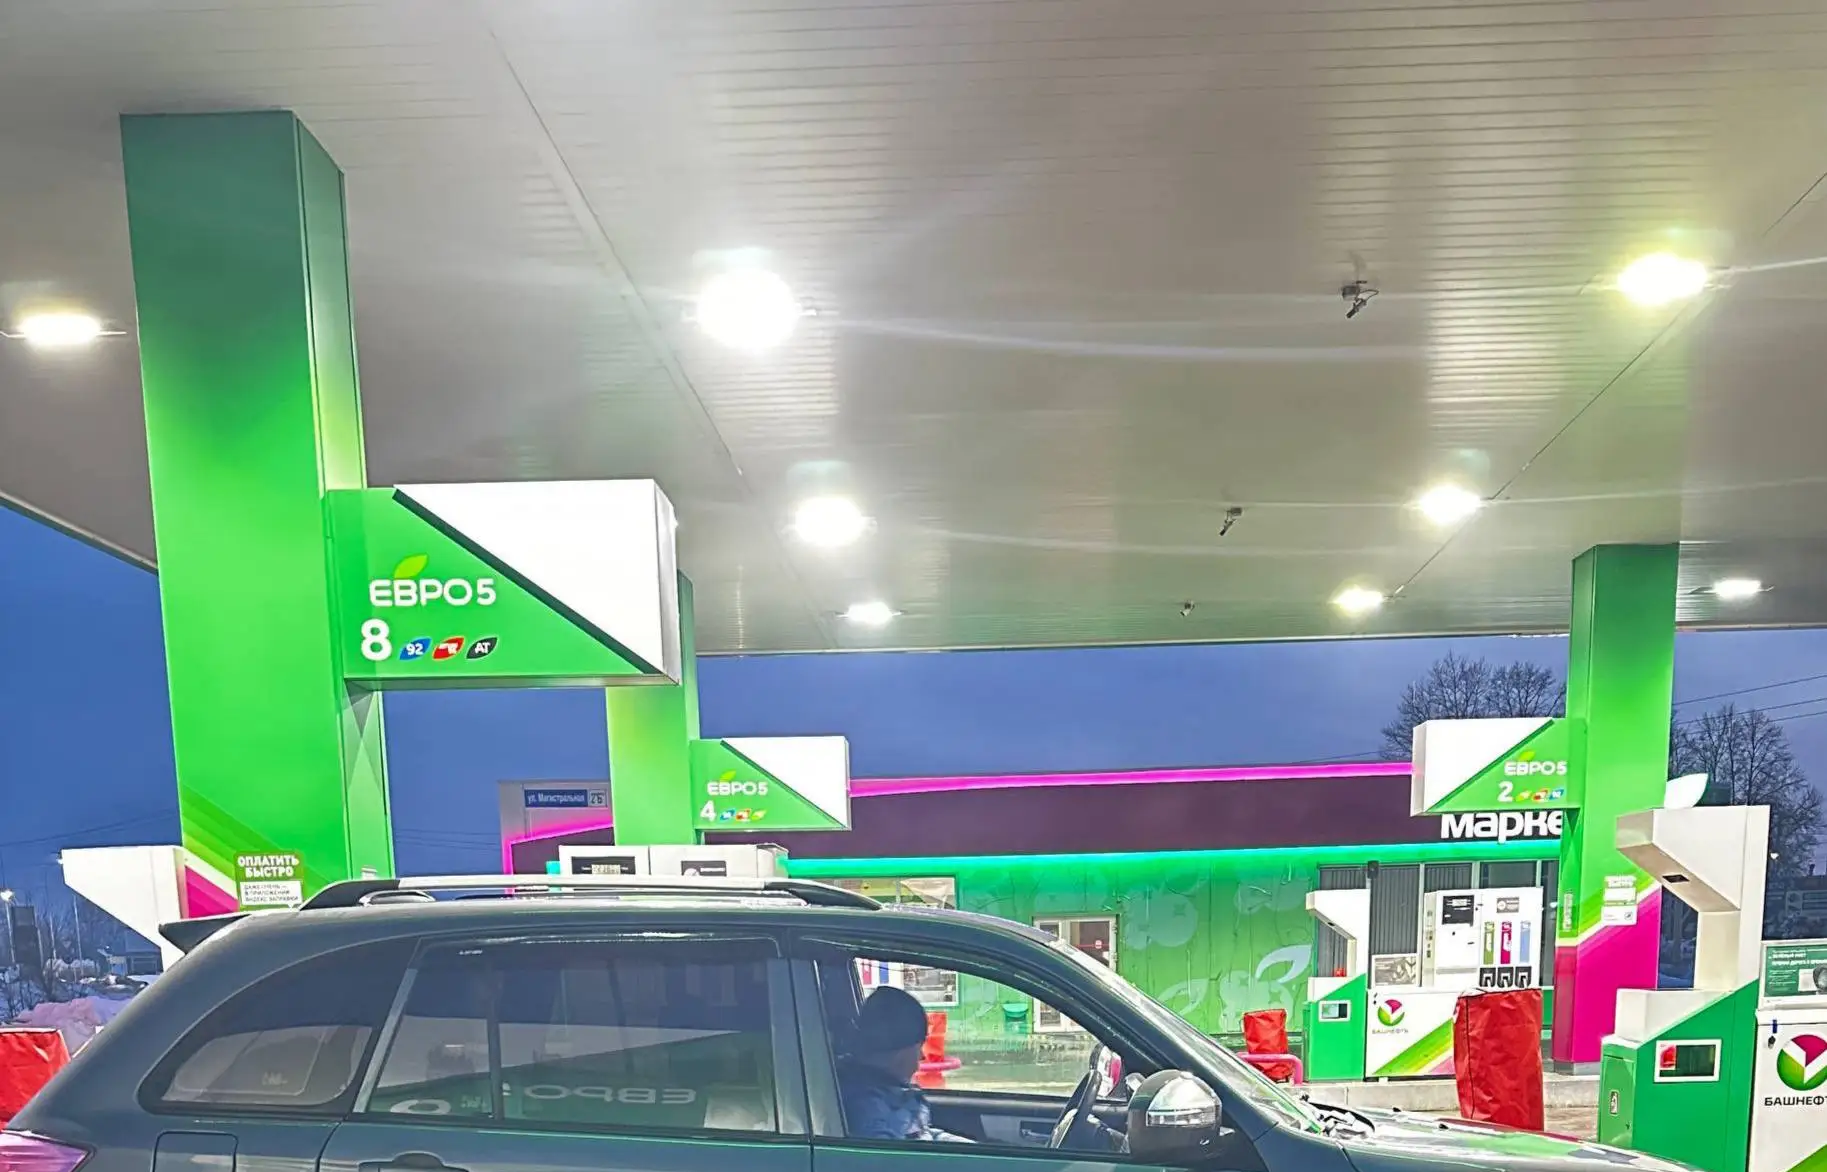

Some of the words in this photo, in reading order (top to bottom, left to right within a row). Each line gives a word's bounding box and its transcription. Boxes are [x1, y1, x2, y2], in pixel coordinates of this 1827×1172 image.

[361, 618, 393, 661] 8
[405, 643, 424, 656] 92
[1498, 781, 1514, 802] 2
[700, 799, 718, 822] 4
[237, 855, 300, 867] ОПЛАТИТЬ
[245, 866, 294, 878] БЫСТРО
[1764, 1095, 1827, 1106] БАШНЕФ
